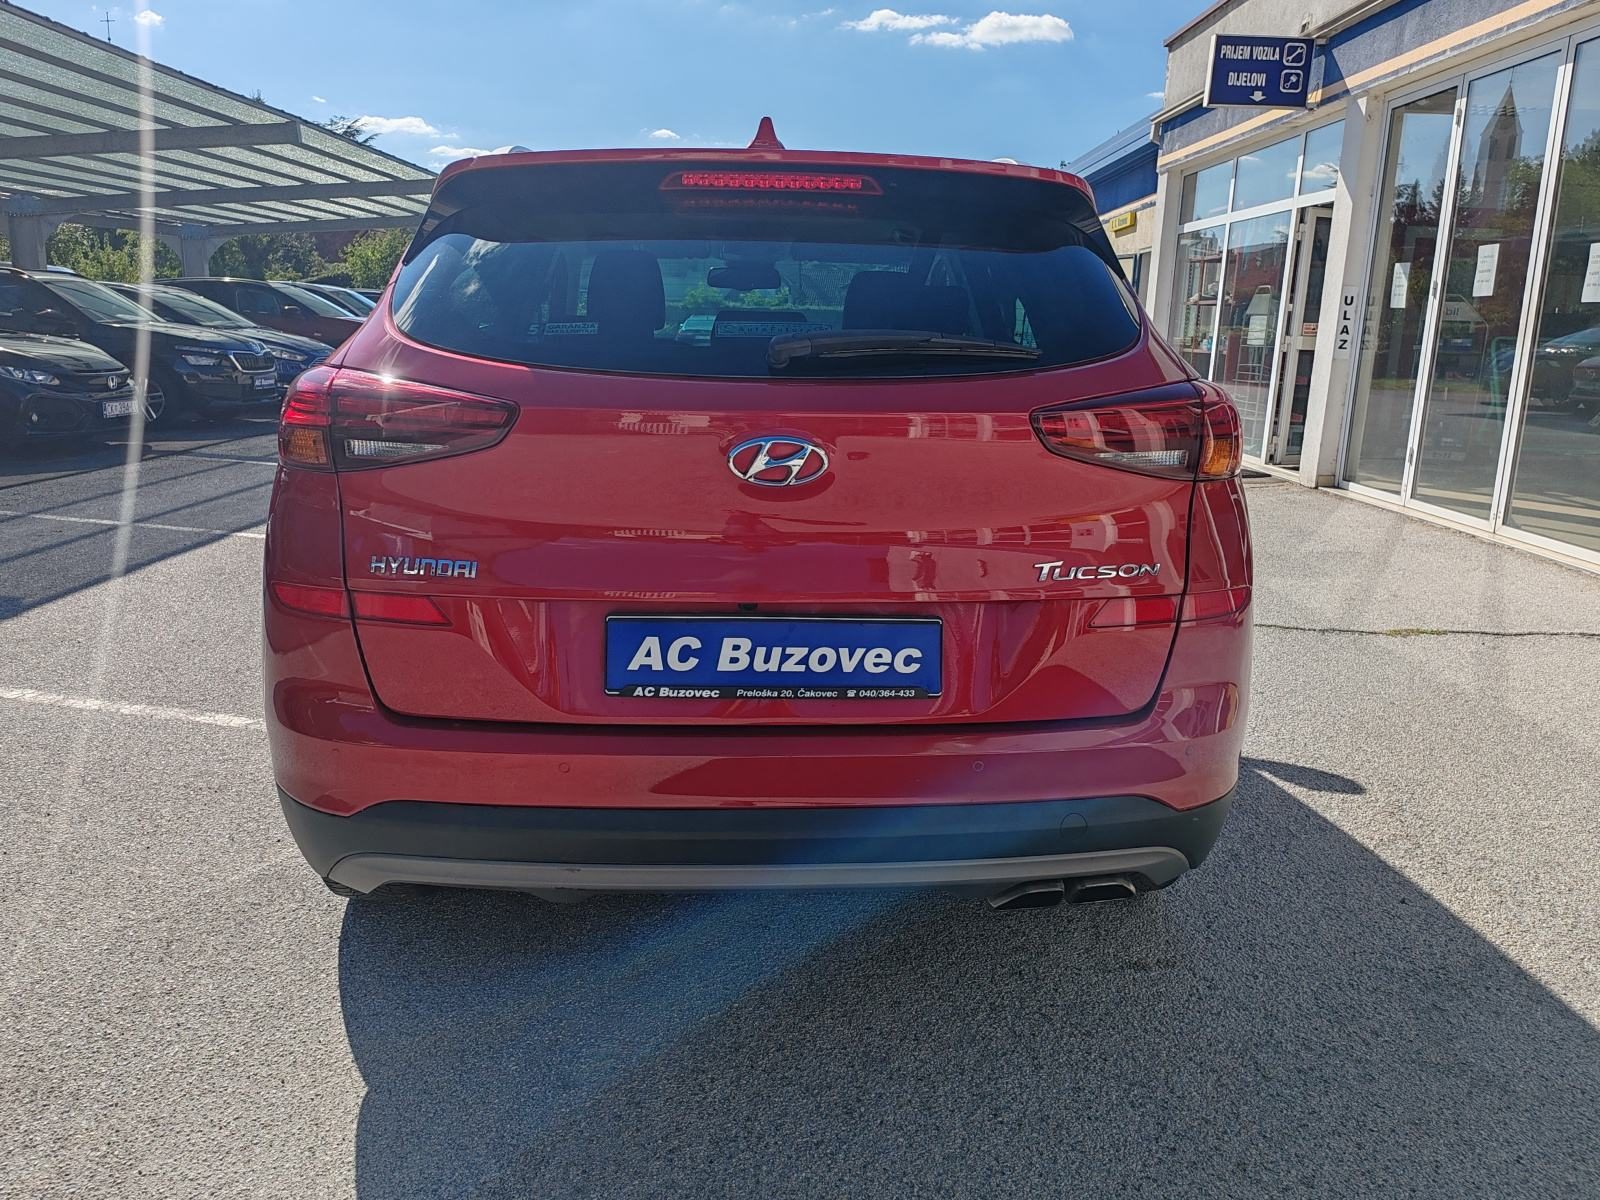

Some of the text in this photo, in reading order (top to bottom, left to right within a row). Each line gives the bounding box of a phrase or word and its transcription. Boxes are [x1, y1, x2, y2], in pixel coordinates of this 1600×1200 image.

[1220, 45, 1280, 61] PRIJEM VOZILA
[1227, 72, 1267, 87] DIJELOVI
[1338, 295, 1354, 350] ULAZ
[370, 555, 478, 579] HYUNDAI
[627, 636, 923, 674] AC Buzovec
[633, 686, 915, 698] AC Buzovec Preloška 20, Čakovec 040/364-433
